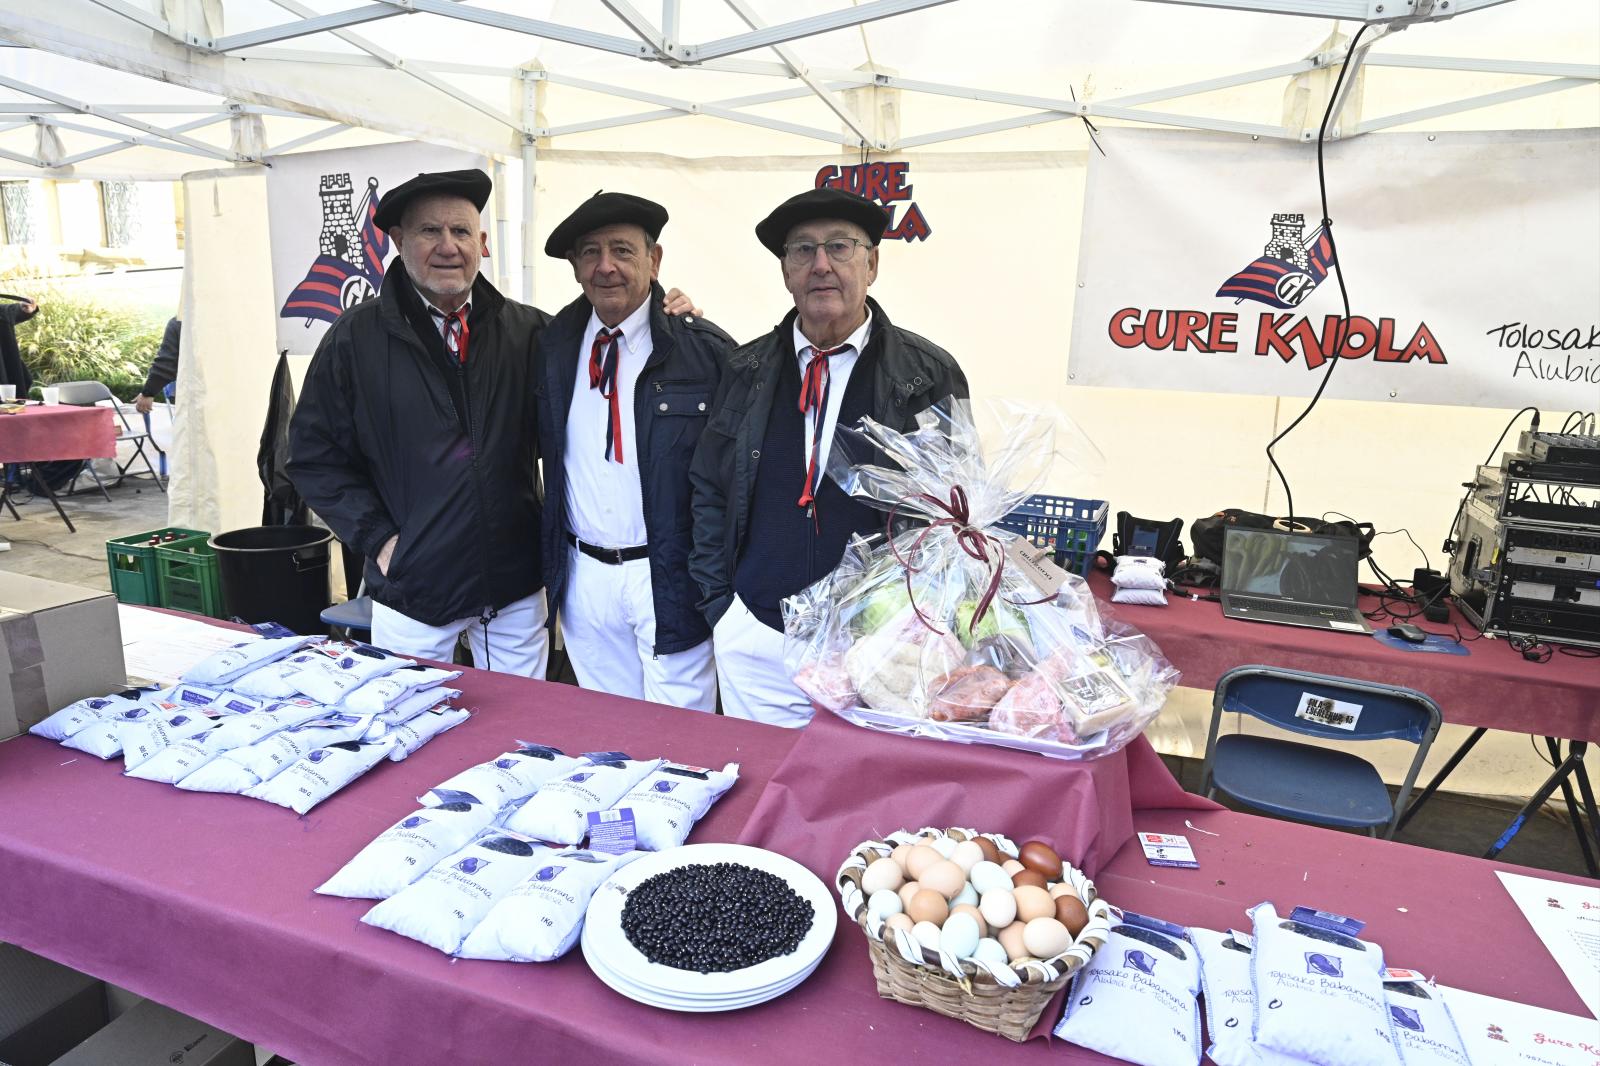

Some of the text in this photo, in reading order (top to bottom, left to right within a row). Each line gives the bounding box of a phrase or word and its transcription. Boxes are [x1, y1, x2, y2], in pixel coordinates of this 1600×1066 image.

[815, 161, 913, 206] GURE
[1108, 307, 1449, 371] GURE KAIOLA
